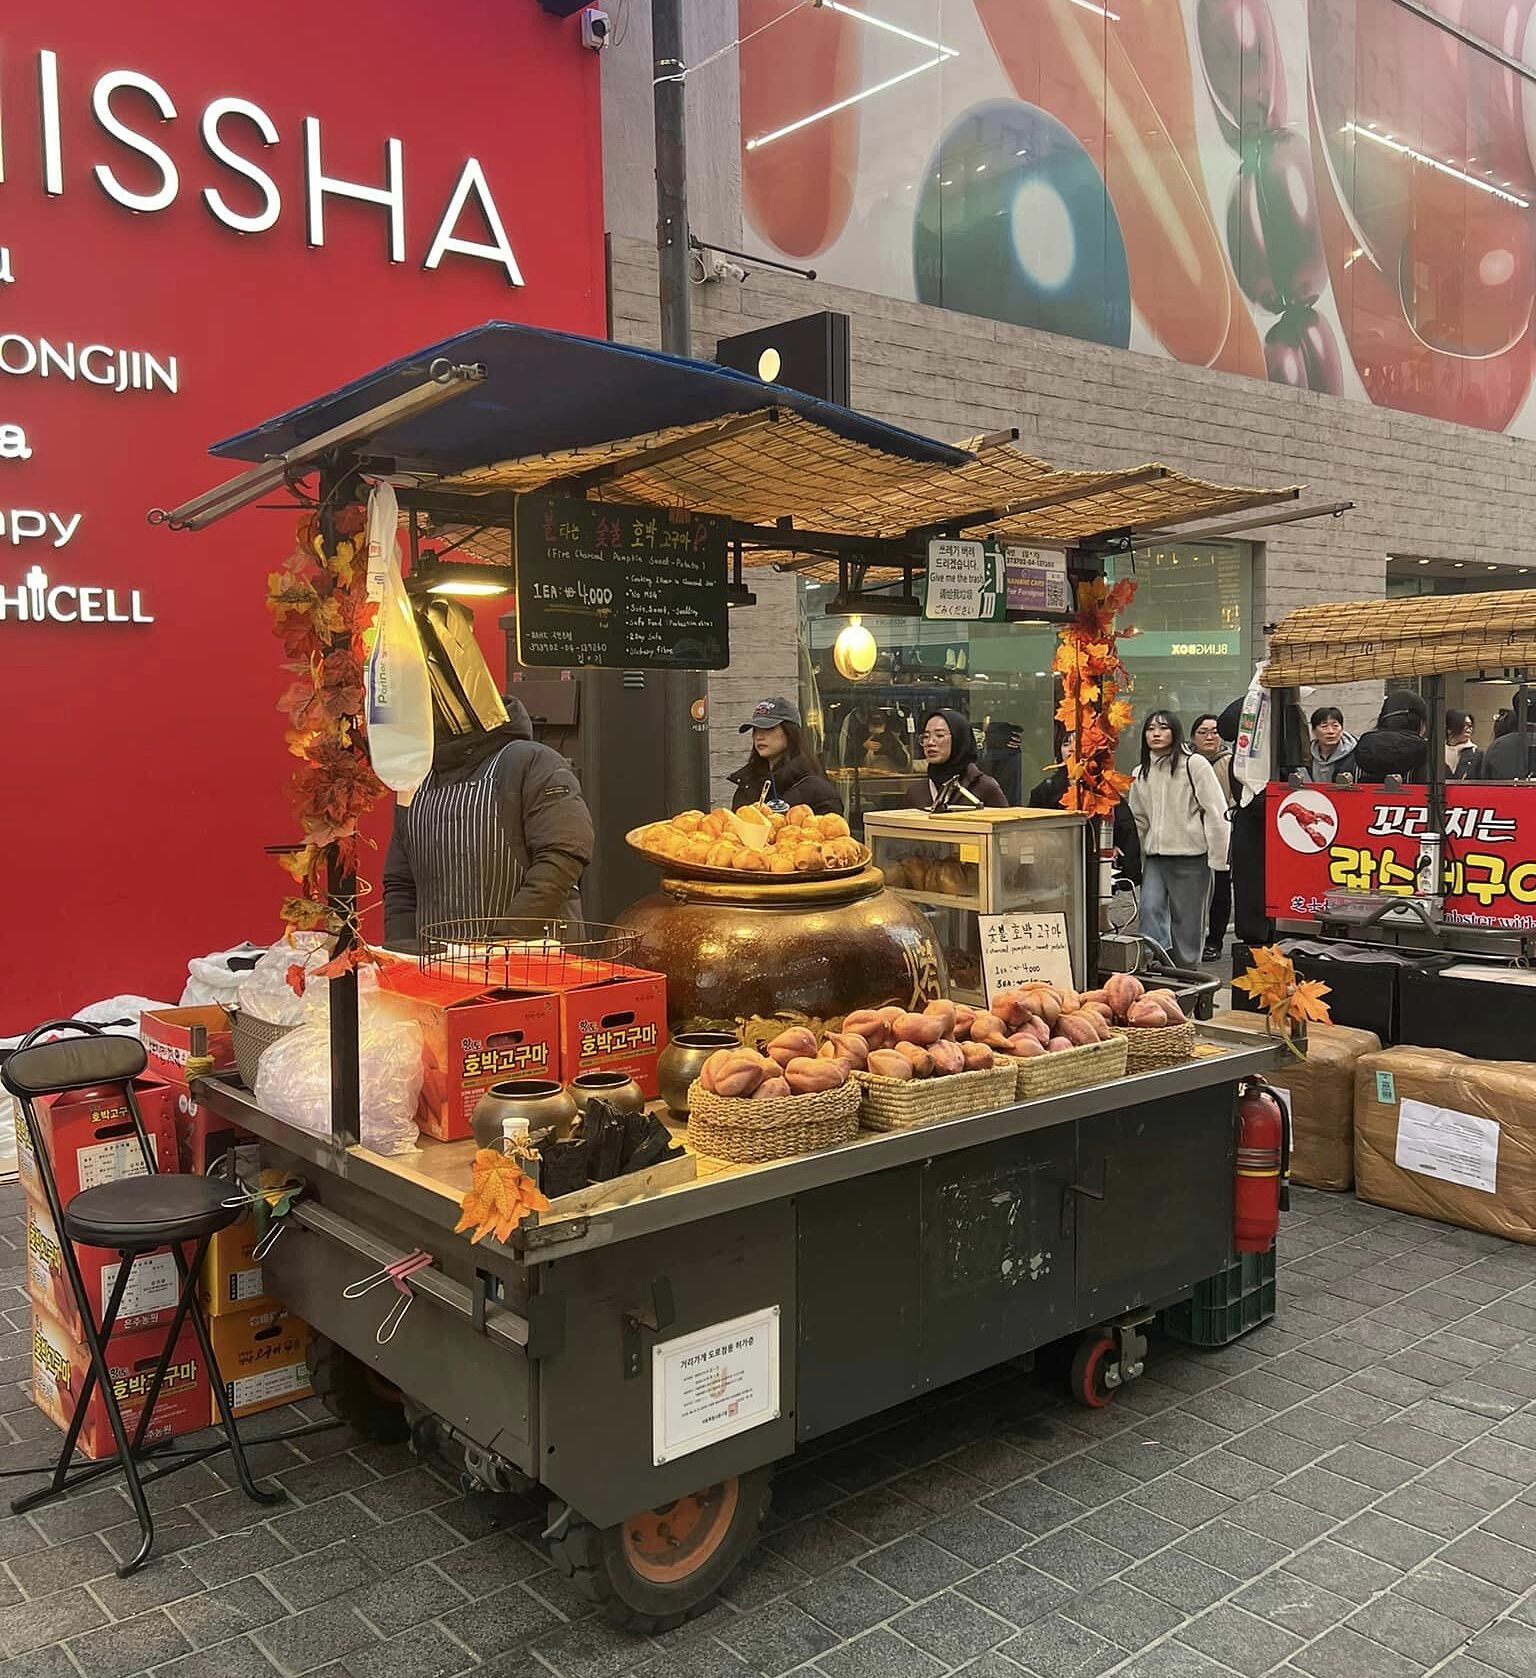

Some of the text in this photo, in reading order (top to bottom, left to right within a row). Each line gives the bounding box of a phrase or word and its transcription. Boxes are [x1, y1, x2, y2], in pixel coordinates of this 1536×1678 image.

[0, 48, 525, 287] ISSHA
[0, 334, 177, 393] ONGJIN
[0, 509, 82, 547] py
[559, 522, 581, 541] 타는
[631, 518, 657, 548] 호박
[659, 530, 691, 551] 고구마
[938, 545, 975, 557] 쓰레기 버려
[930, 572, 945, 582] Give
[945, 575, 956, 583] me
[957, 574, 968, 583] the
[1290, 897, 1330, 913] 芝士
[1011, 922, 1033, 940] 호박
[1037, 922, 1061, 938] 고구마
[580, 1022, 657, 1058] 호박고구마
[462, 1041, 549, 1078] 호박고구마
[90, 1106, 130, 1122] 호박고구
